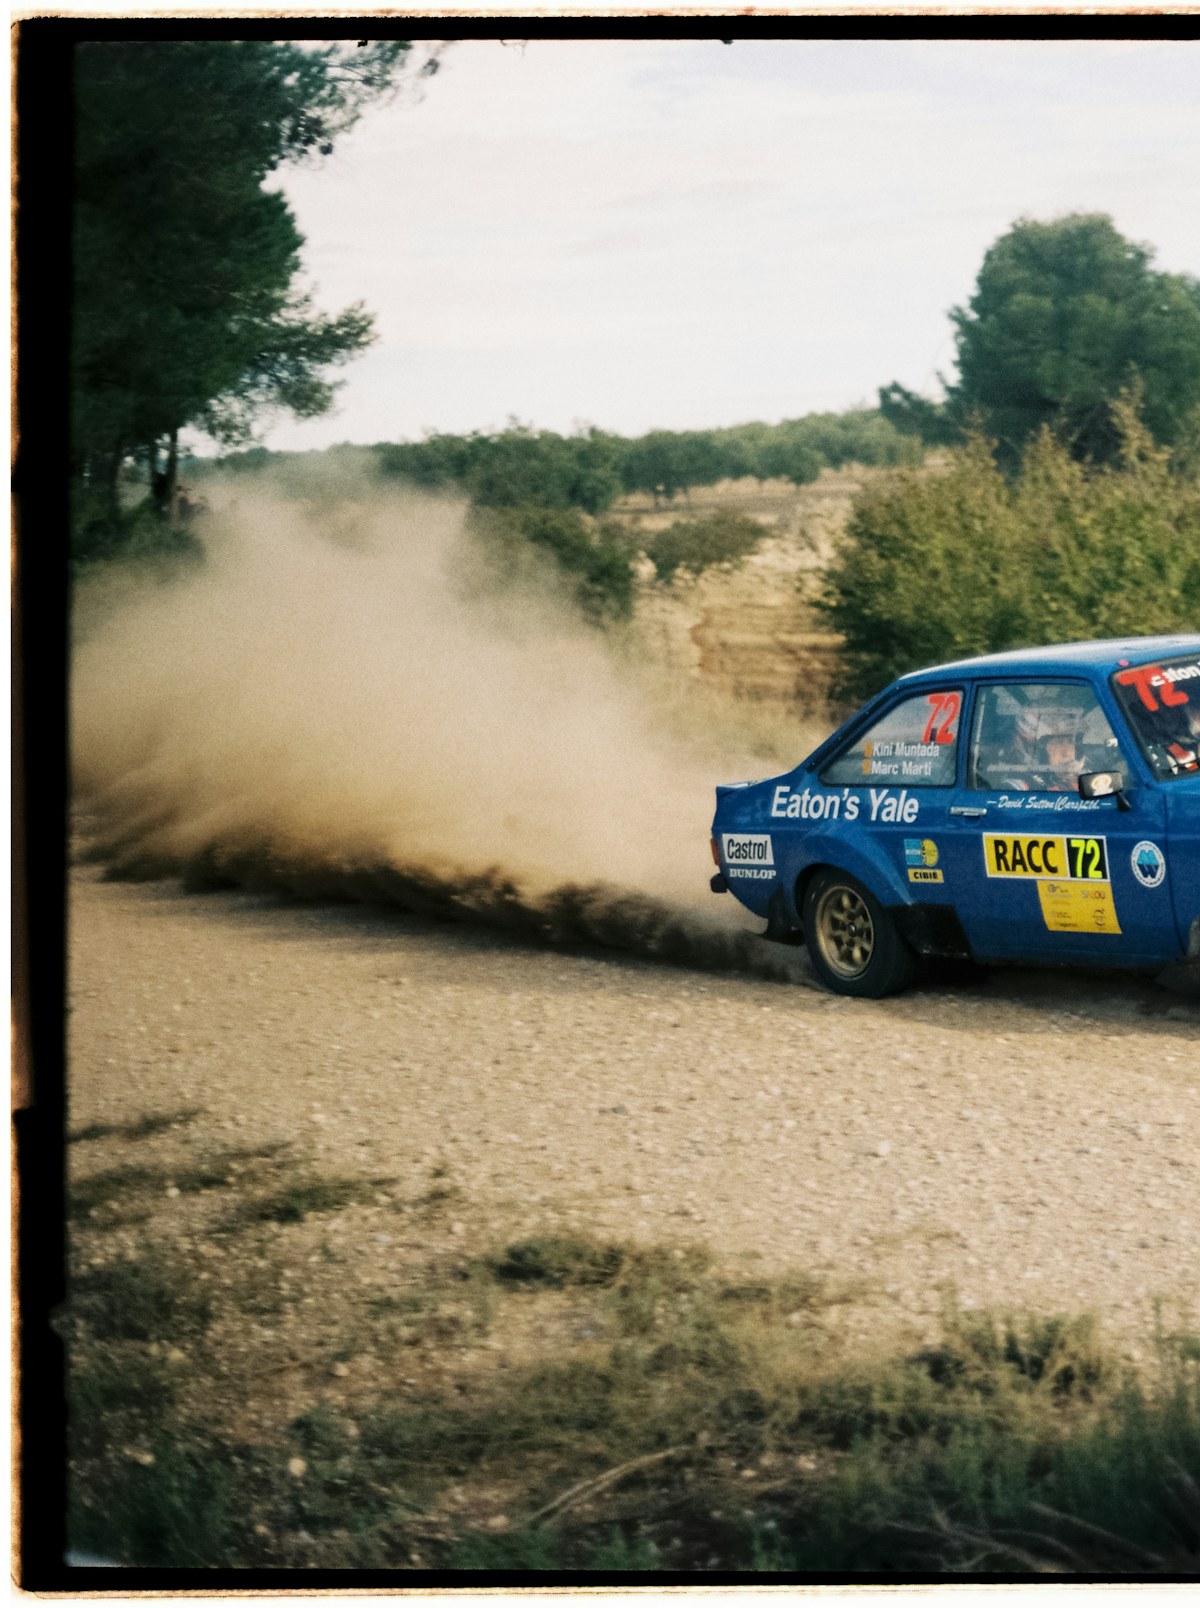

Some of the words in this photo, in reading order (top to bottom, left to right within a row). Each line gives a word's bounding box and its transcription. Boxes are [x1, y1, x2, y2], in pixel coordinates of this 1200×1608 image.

[1117, 665, 1189, 712] 72
[922, 691, 959, 745] 72
[872, 742, 893, 757] Kini
[894, 742, 940, 757] Muntada
[871, 761, 899, 775] Marc
[770, 786, 861, 821] Eaton's
[869, 788, 919, 823] Yale
[997, 795, 1025, 809] David
[1025, 796, 1055, 810] Sutton
[727, 838, 768, 860] Castrol
[993, 839, 1059, 874] RACC
[1070, 838, 1103, 879] 72
[729, 868, 777, 880] DUNLOP
